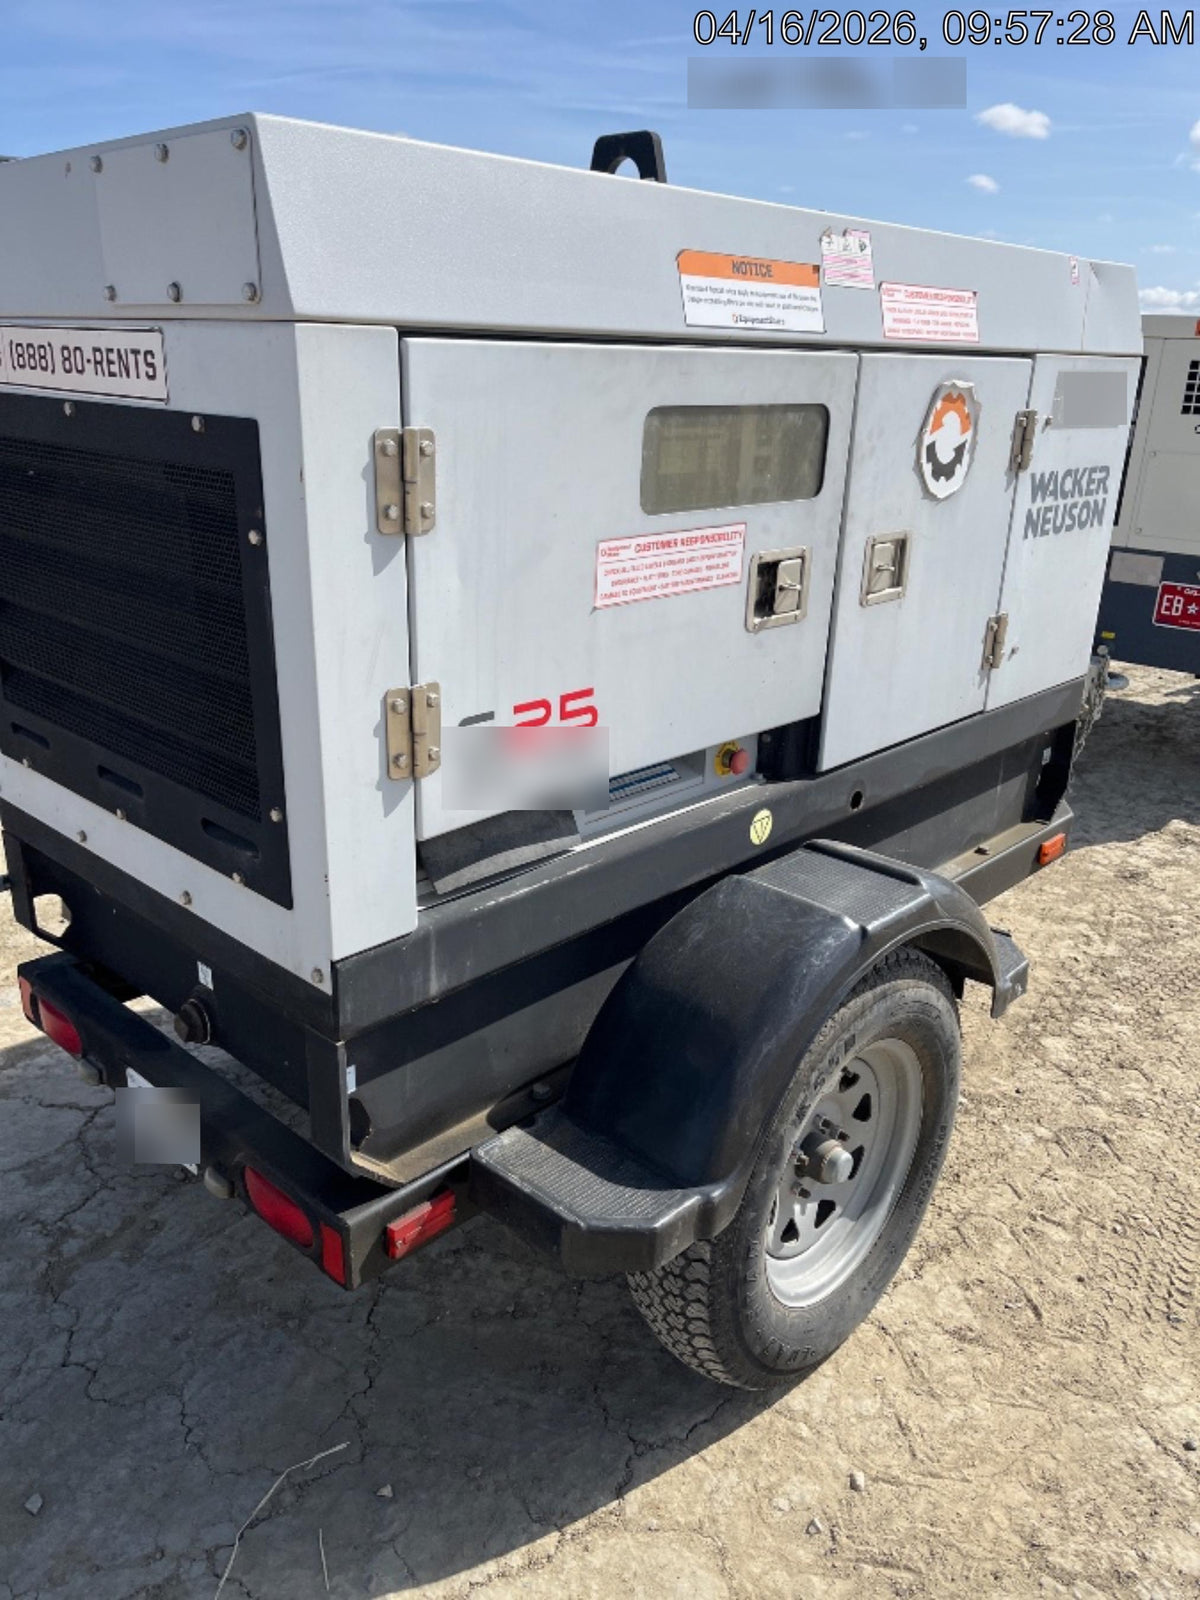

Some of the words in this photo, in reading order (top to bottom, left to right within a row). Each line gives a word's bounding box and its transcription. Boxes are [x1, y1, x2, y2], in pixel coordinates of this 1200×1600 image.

[731, 259, 774, 278] NOTICE
[9, 339, 55, 375] (888)
[61, 345, 157, 381] 80-RENTS
[1030, 465, 1110, 504] WACKER
[1023, 498, 1107, 540] NEUSON
[634, 537, 679, 554] CUSTOMER
